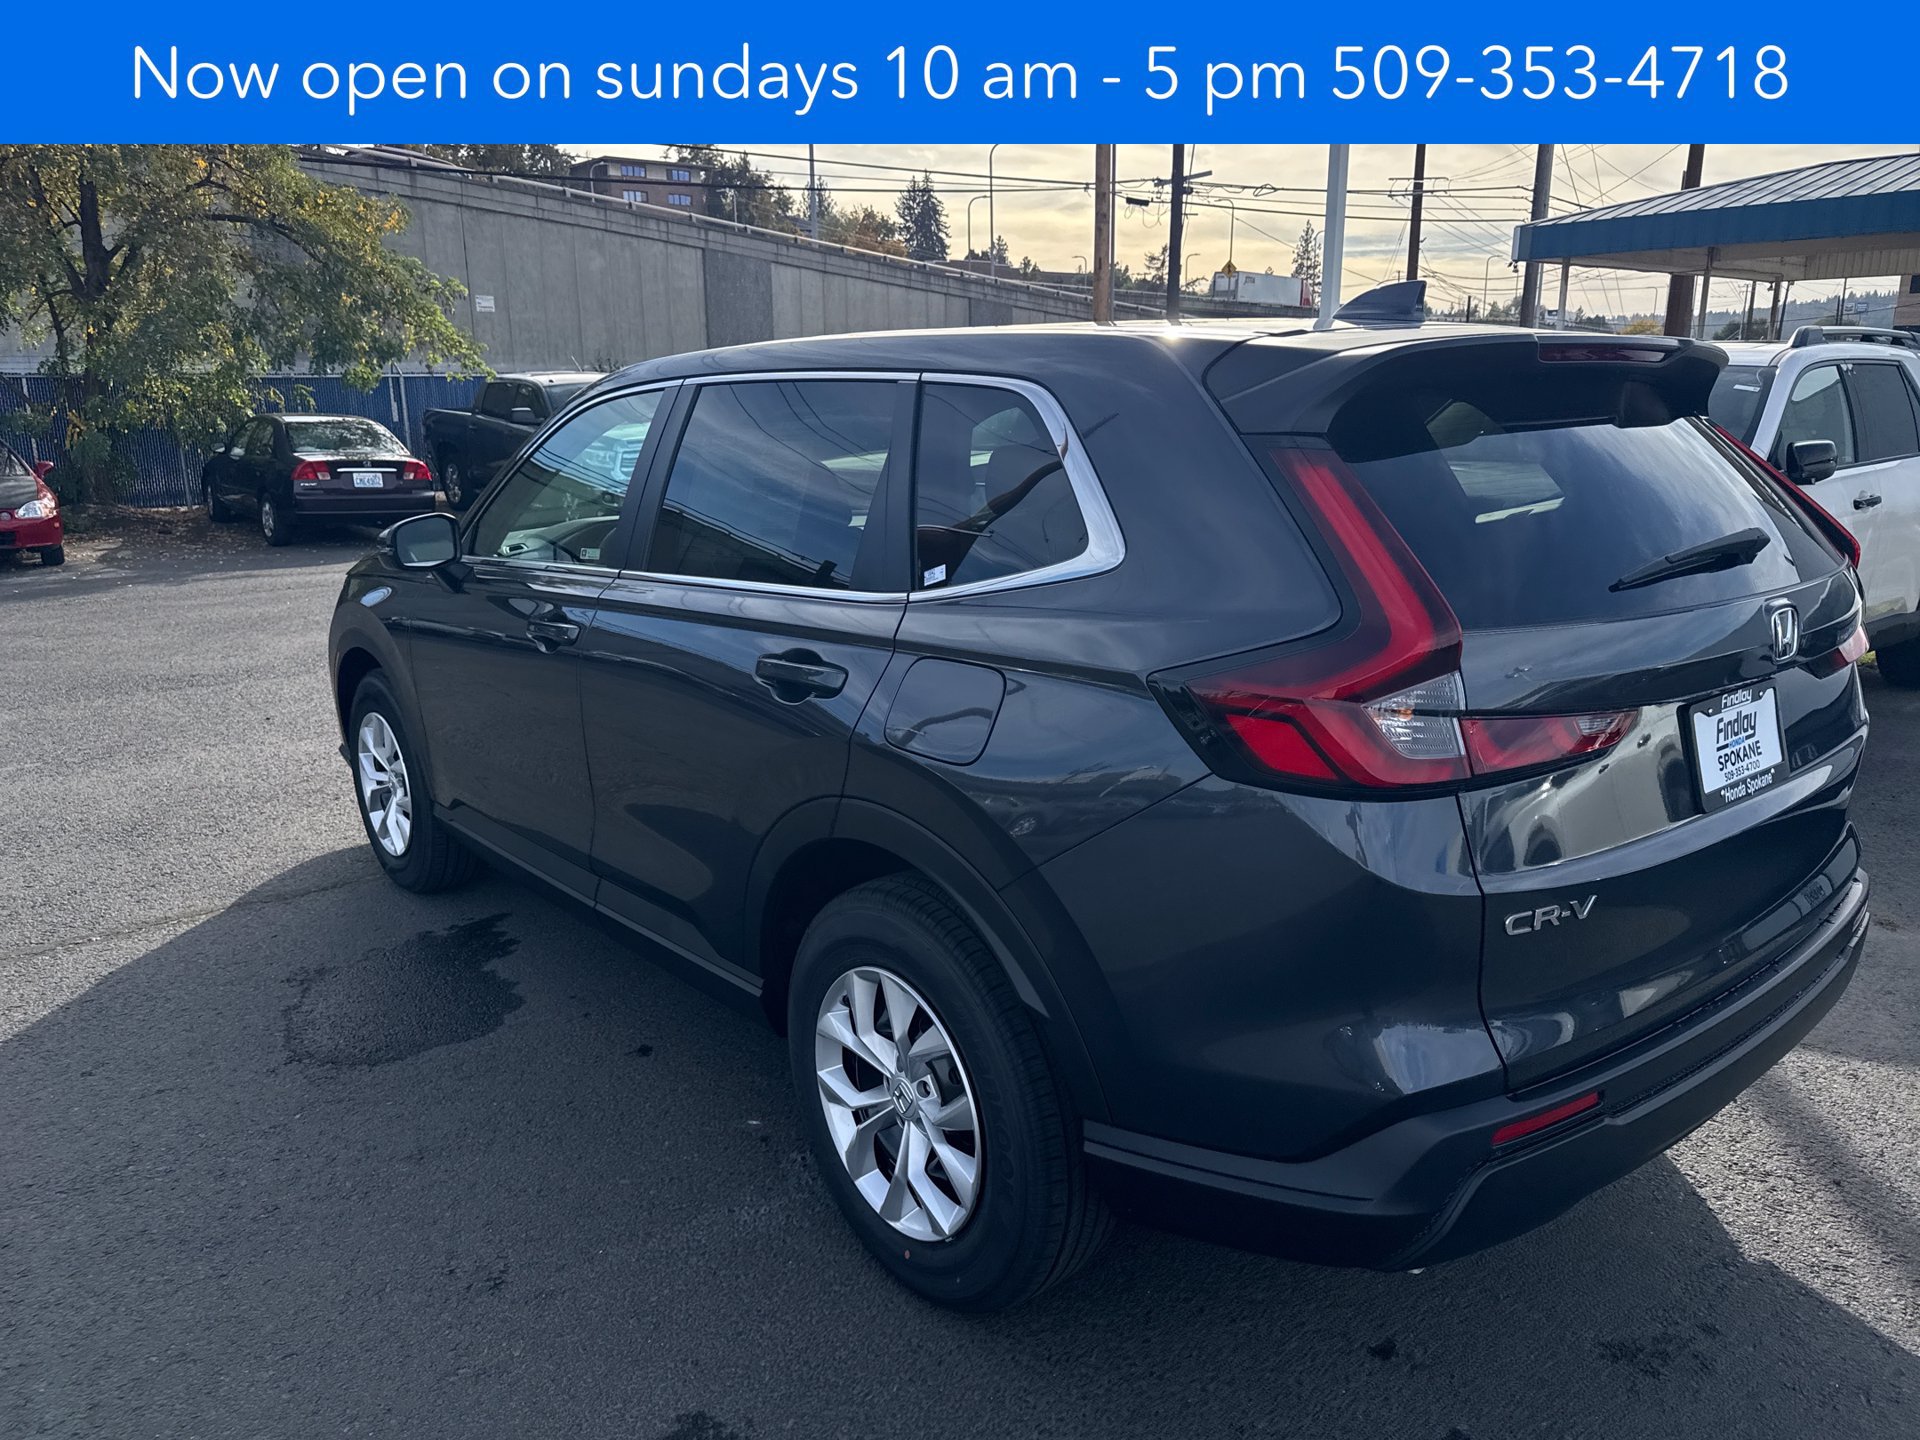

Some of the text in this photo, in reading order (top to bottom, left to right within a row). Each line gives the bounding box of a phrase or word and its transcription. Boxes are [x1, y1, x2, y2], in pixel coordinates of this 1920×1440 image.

[1721, 688, 1753, 711] Findlay
[1716, 709, 1757, 745] Findlay
[1717, 739, 1763, 772] SPOKANE
[1728, 735, 1746, 750] HONDA
[1724, 759, 1761, 783] 509-353-4700
[1504, 894, 1598, 936] CR-V
